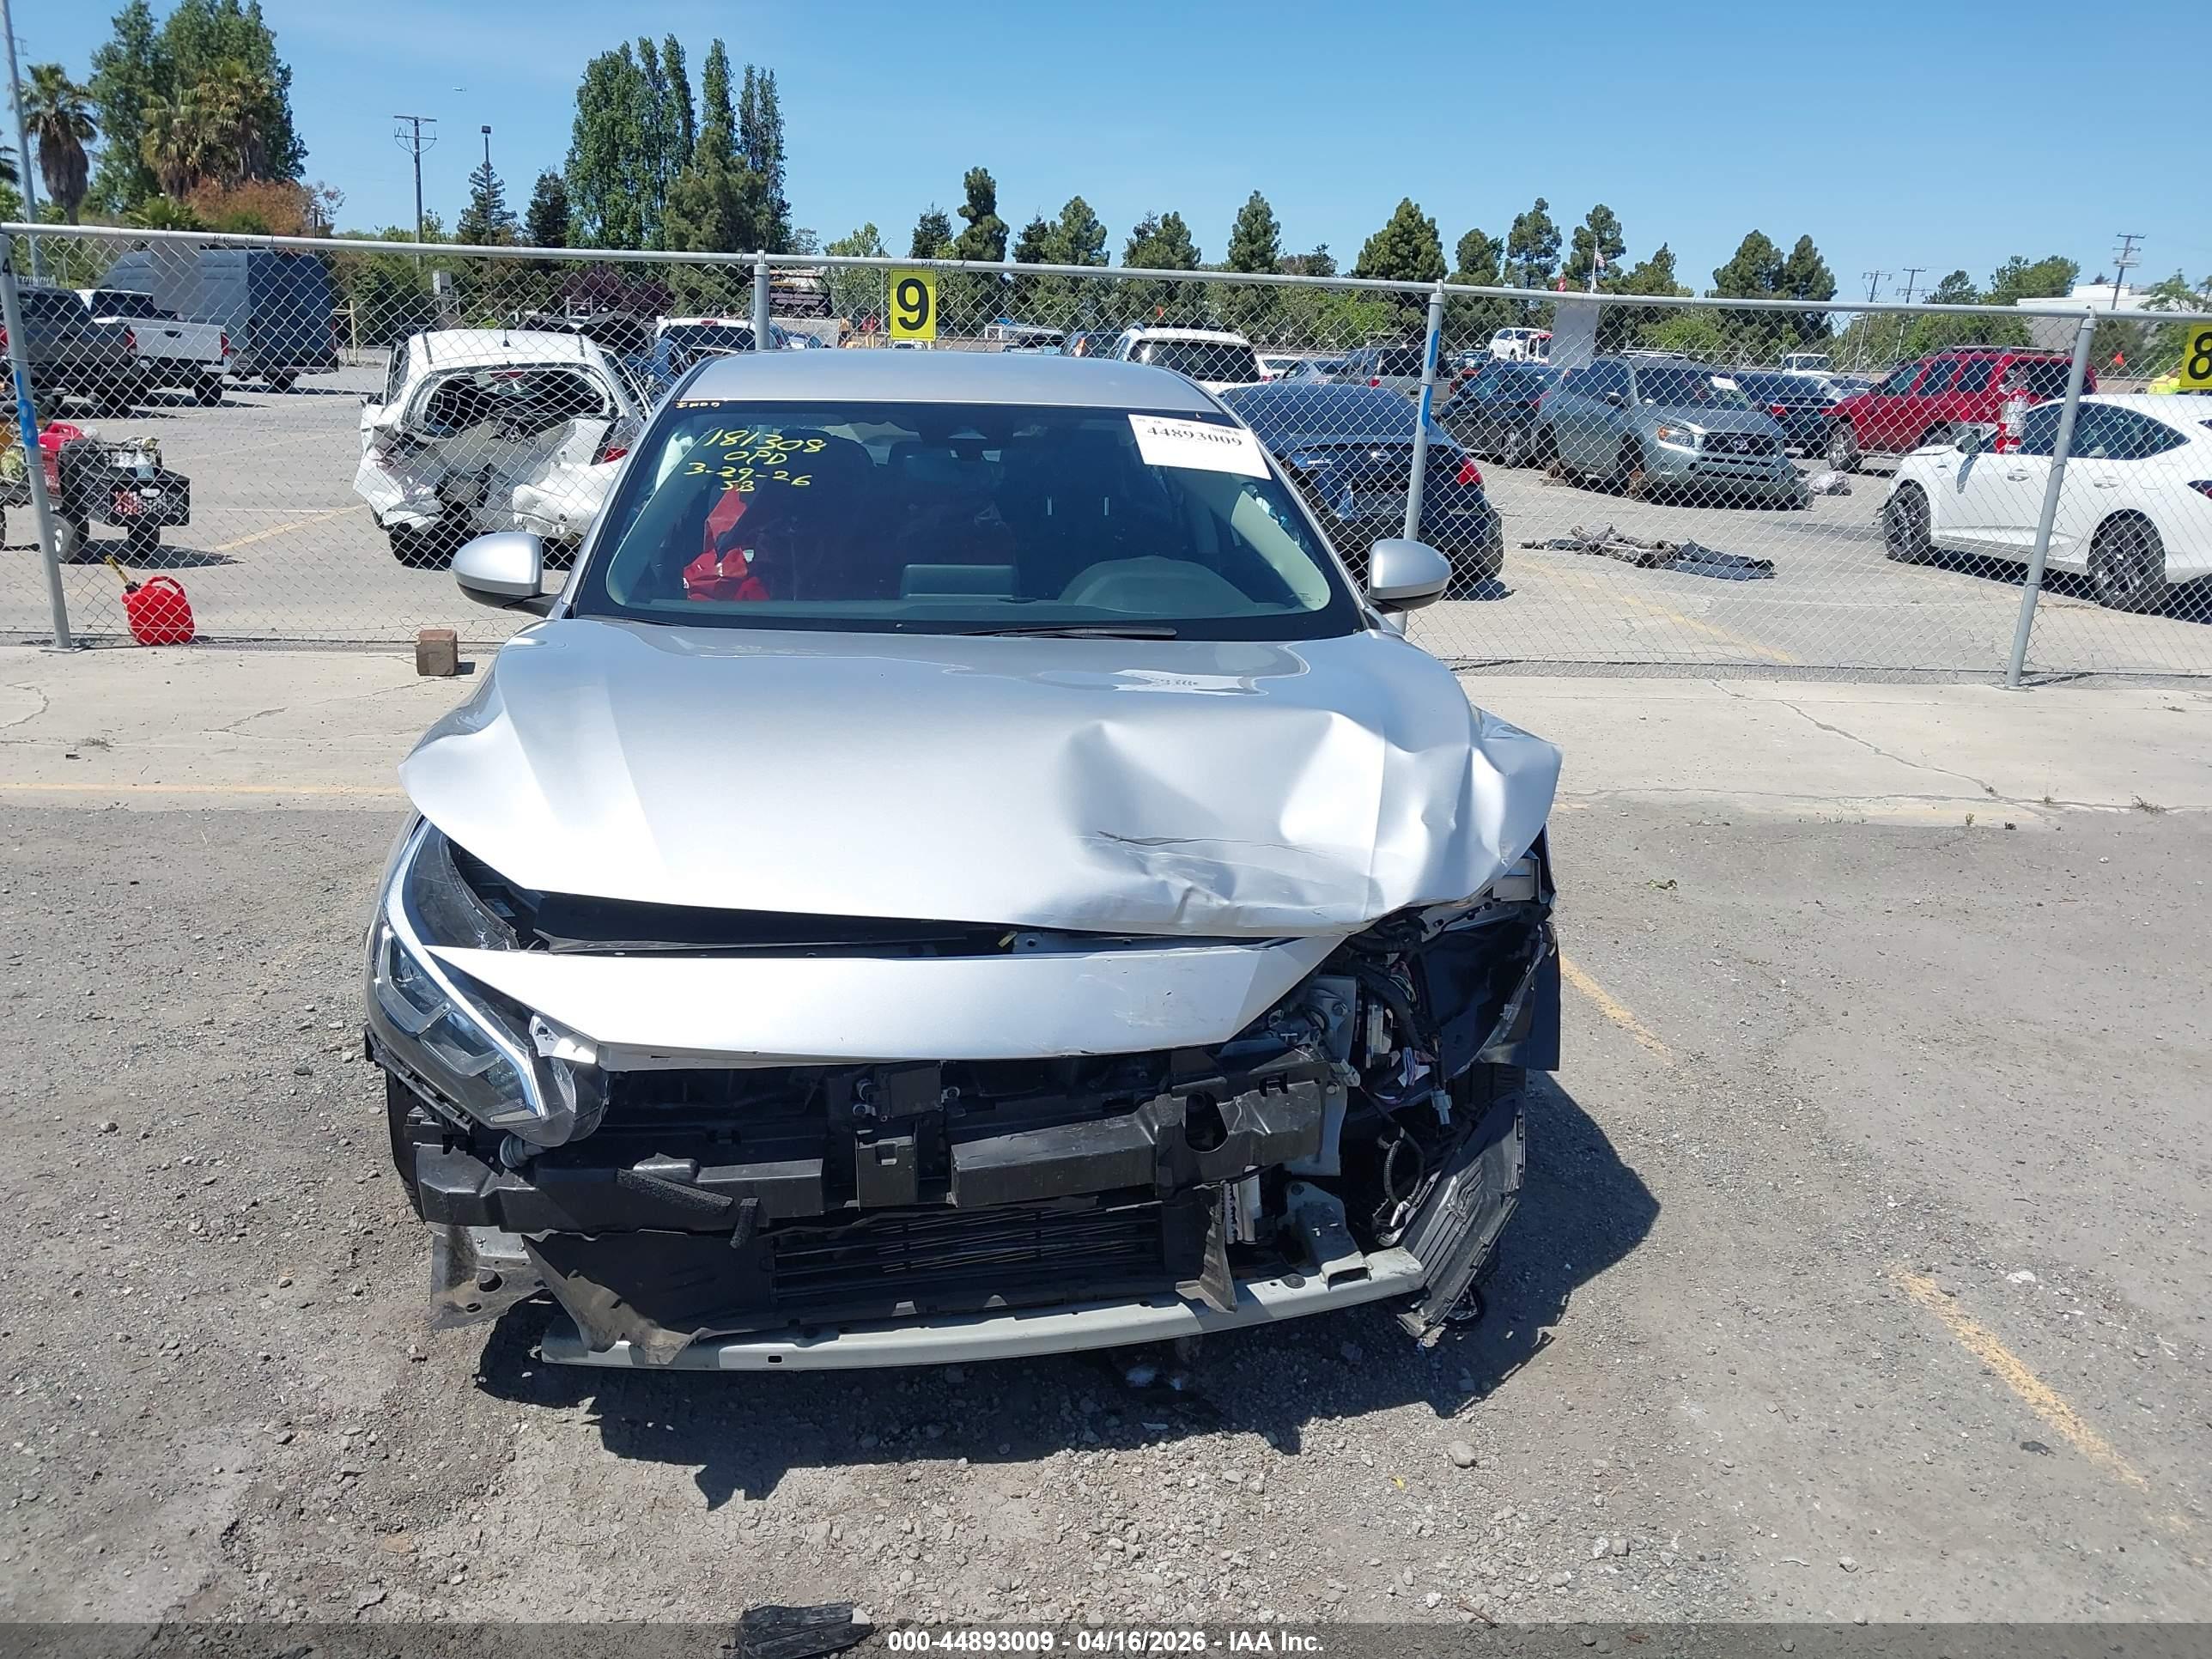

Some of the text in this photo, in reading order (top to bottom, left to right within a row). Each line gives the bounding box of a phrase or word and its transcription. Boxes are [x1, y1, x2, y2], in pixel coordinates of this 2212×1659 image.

[896, 277, 930, 331] 9
[2188, 331, 2212, 380] 8
[704, 428, 828, 453] 181308
[1147, 427, 1243, 446] 44893009
[724, 450, 787, 465] OPD
